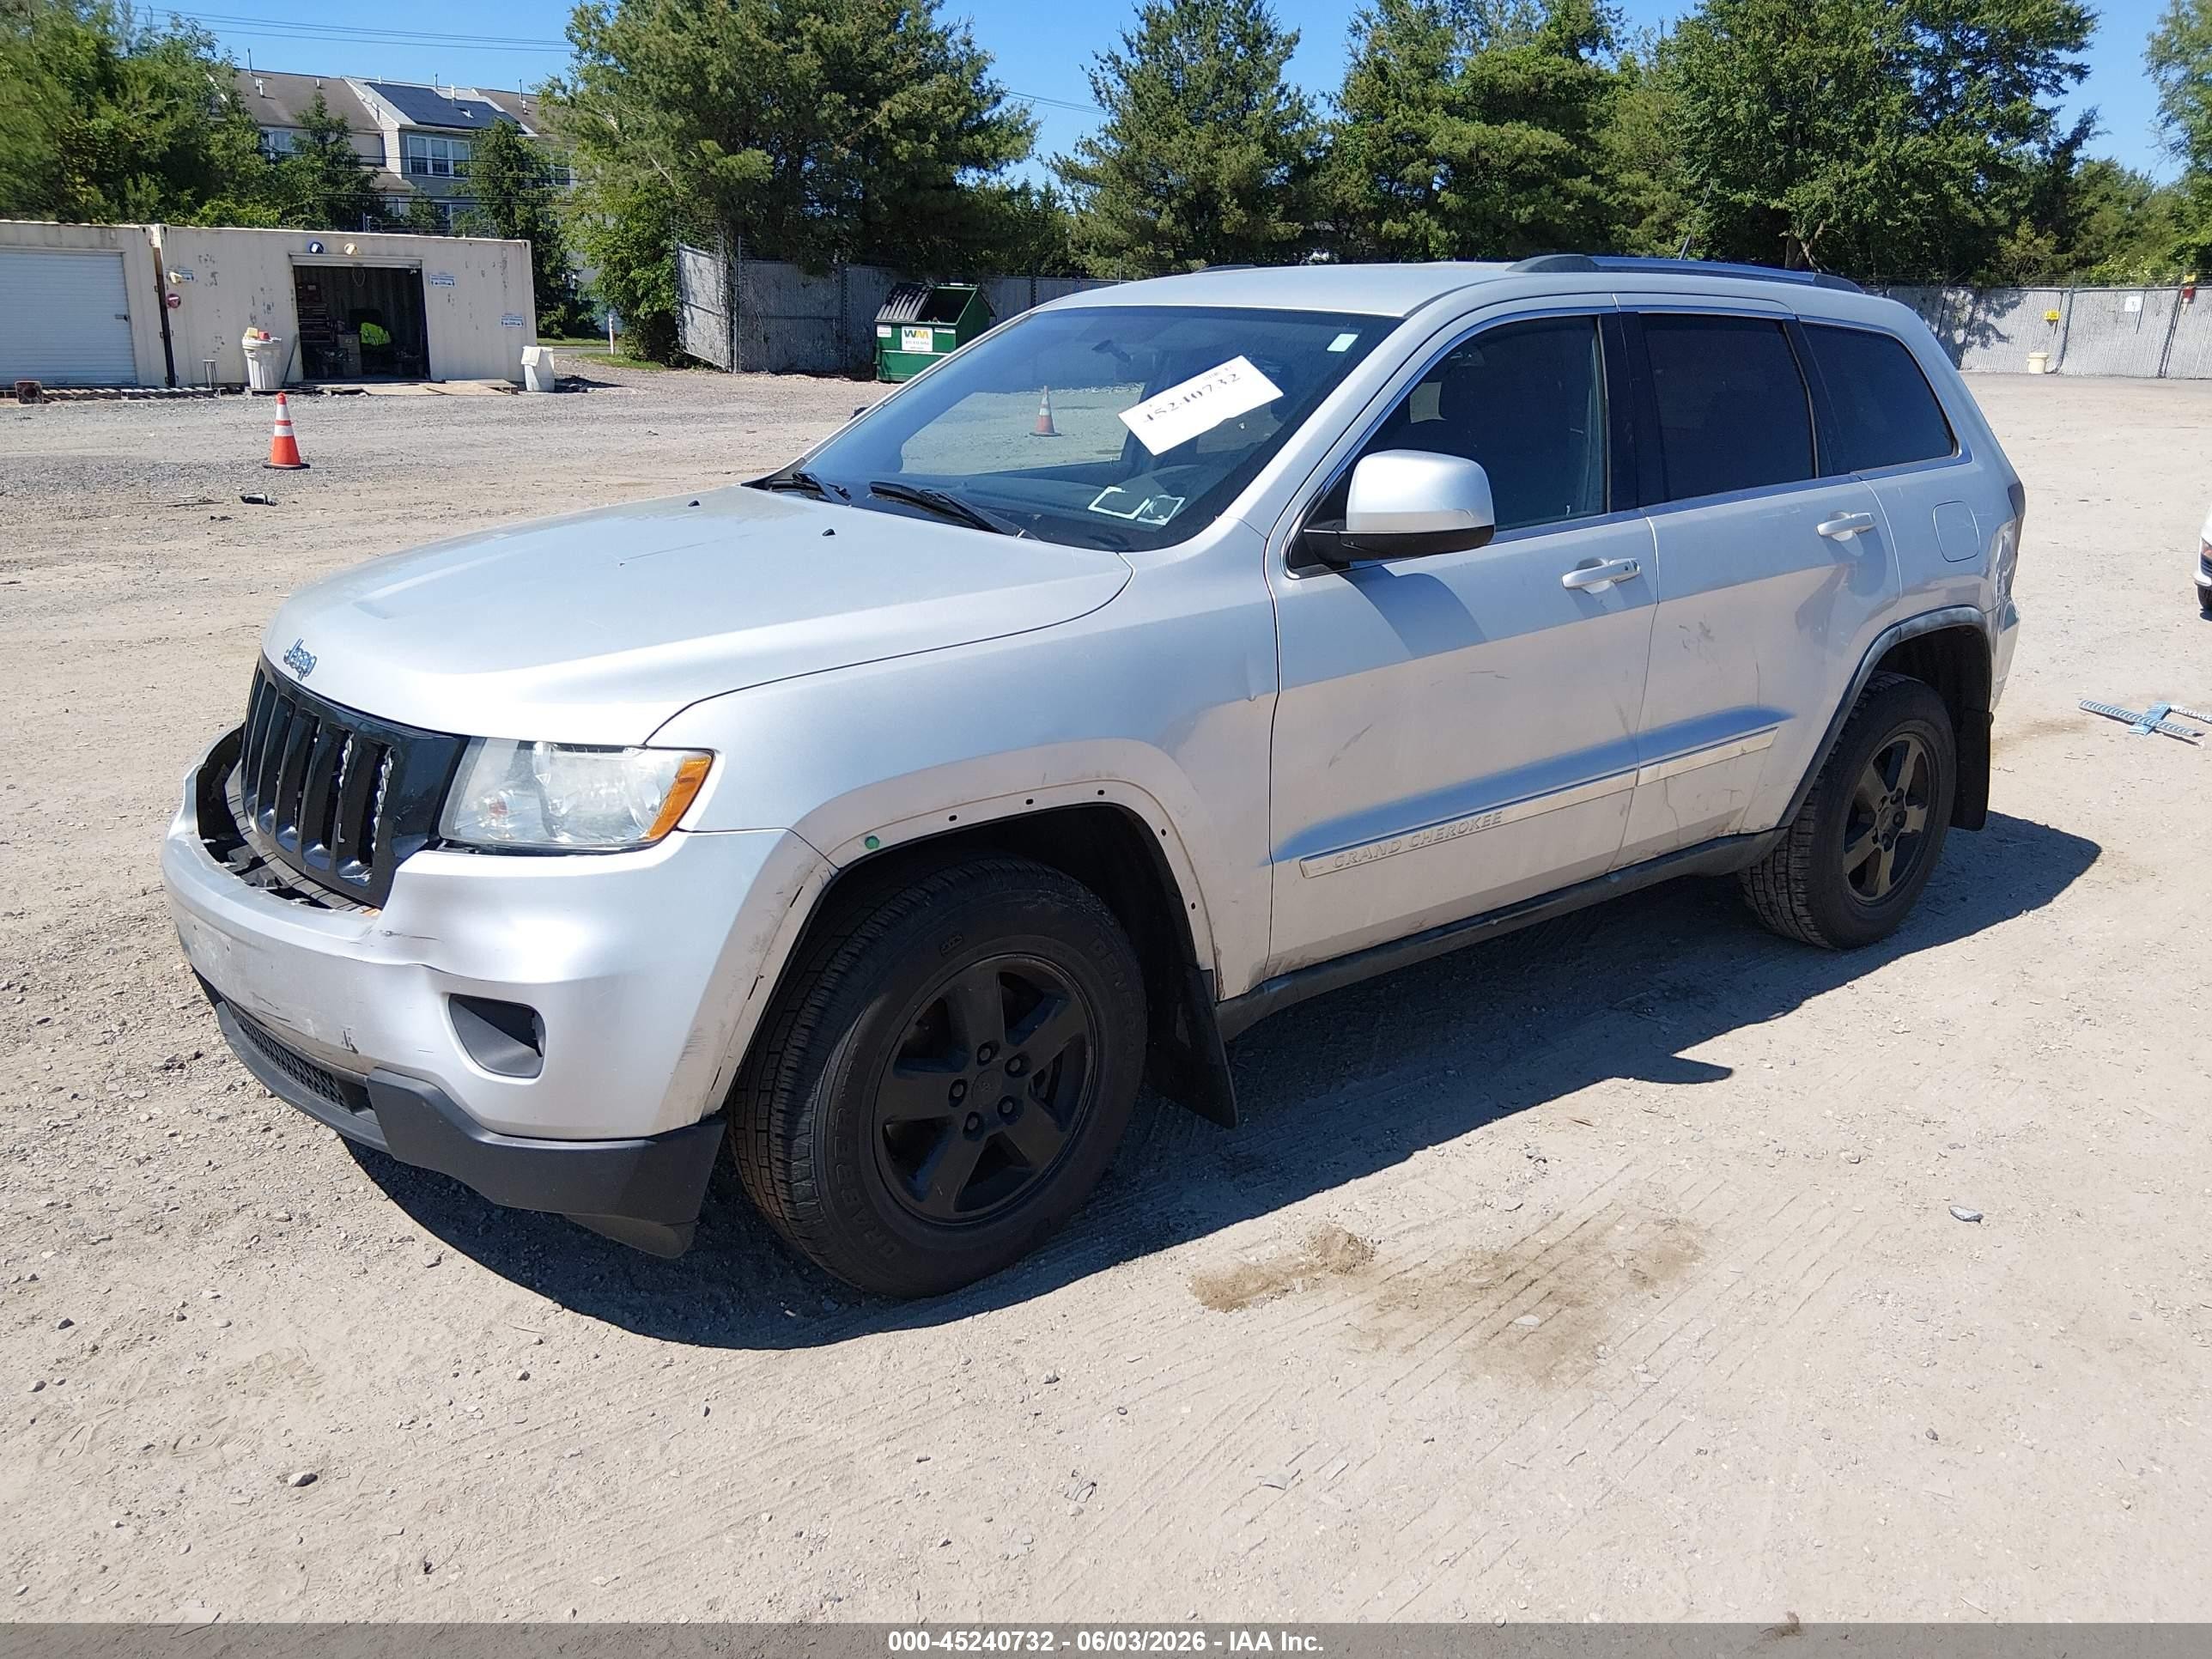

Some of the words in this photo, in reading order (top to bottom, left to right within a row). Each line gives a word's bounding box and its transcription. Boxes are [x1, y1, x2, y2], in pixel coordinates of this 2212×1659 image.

[904, 329, 929, 339] WM
[283, 638, 318, 682] Jeep
[1332, 839, 1402, 869] GRAND
[1408, 811, 1504, 848] CHEROKEE
